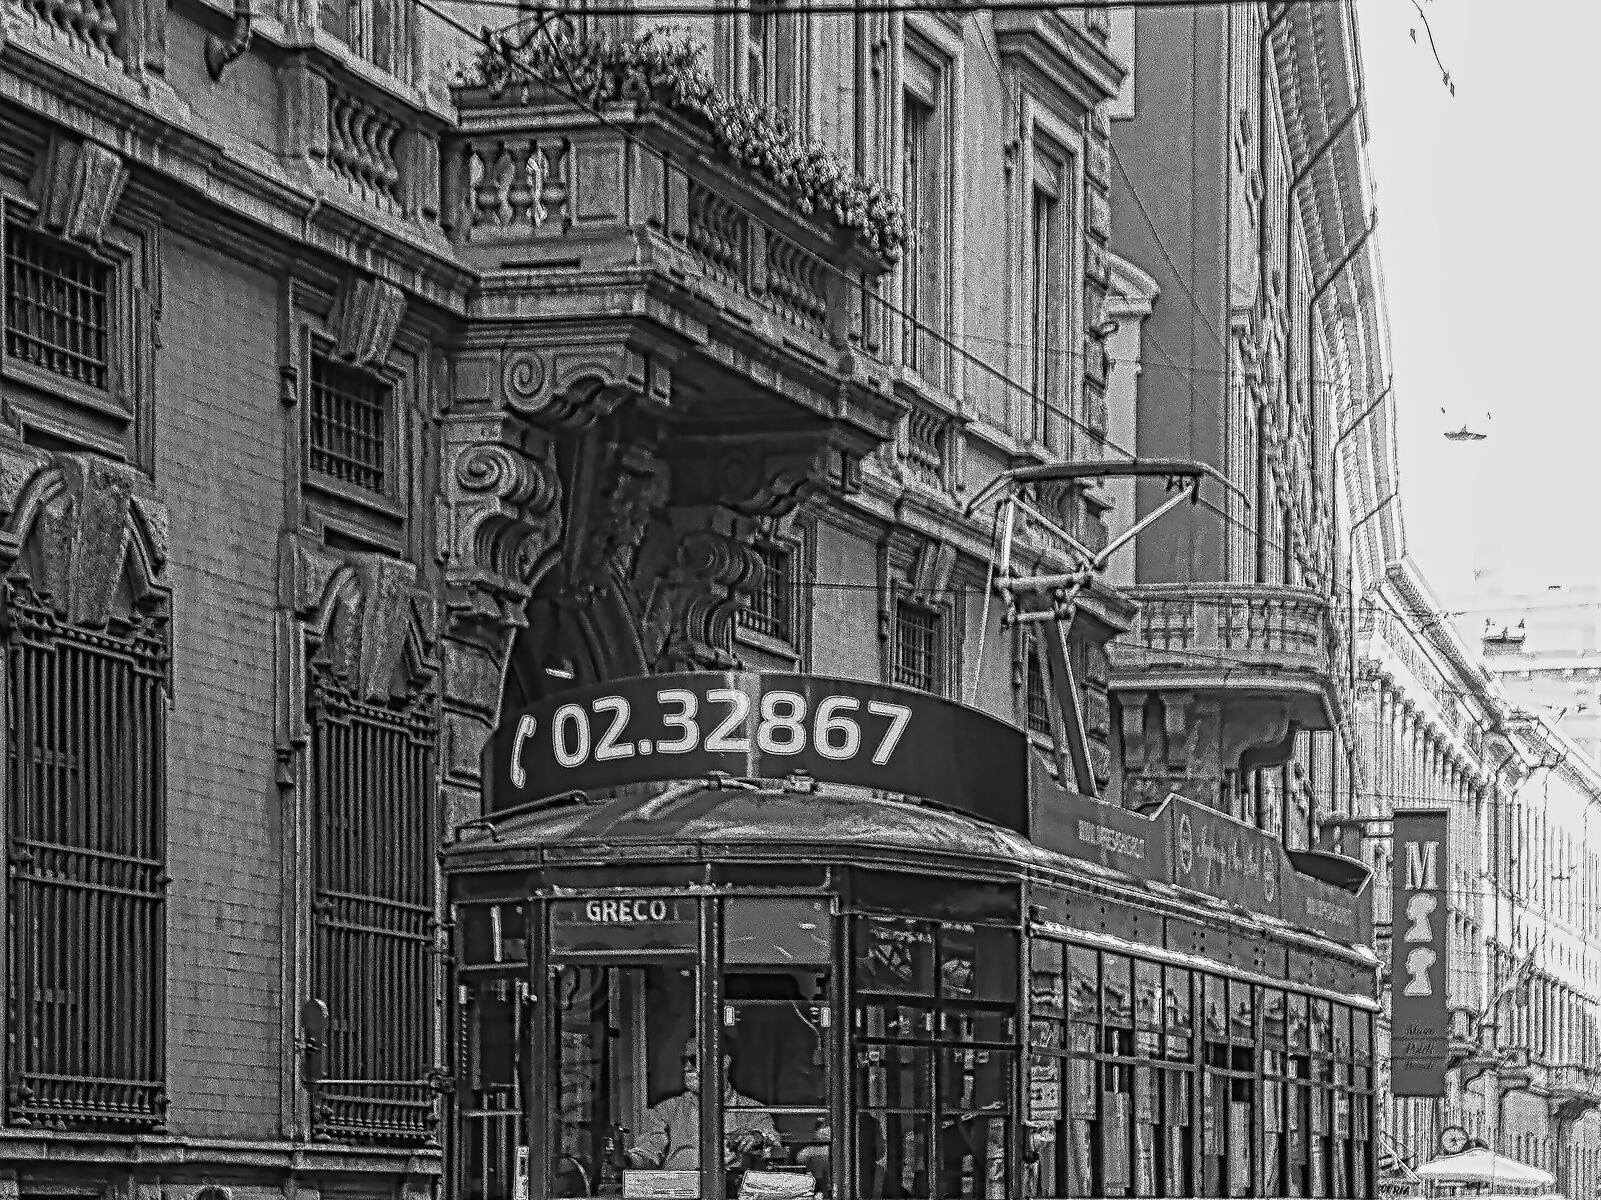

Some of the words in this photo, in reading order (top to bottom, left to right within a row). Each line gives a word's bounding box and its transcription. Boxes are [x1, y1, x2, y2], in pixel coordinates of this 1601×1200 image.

[551, 688, 913, 769] 02.32867
[1404, 840, 1440, 890] M
[586, 899, 667, 922] GRECO
